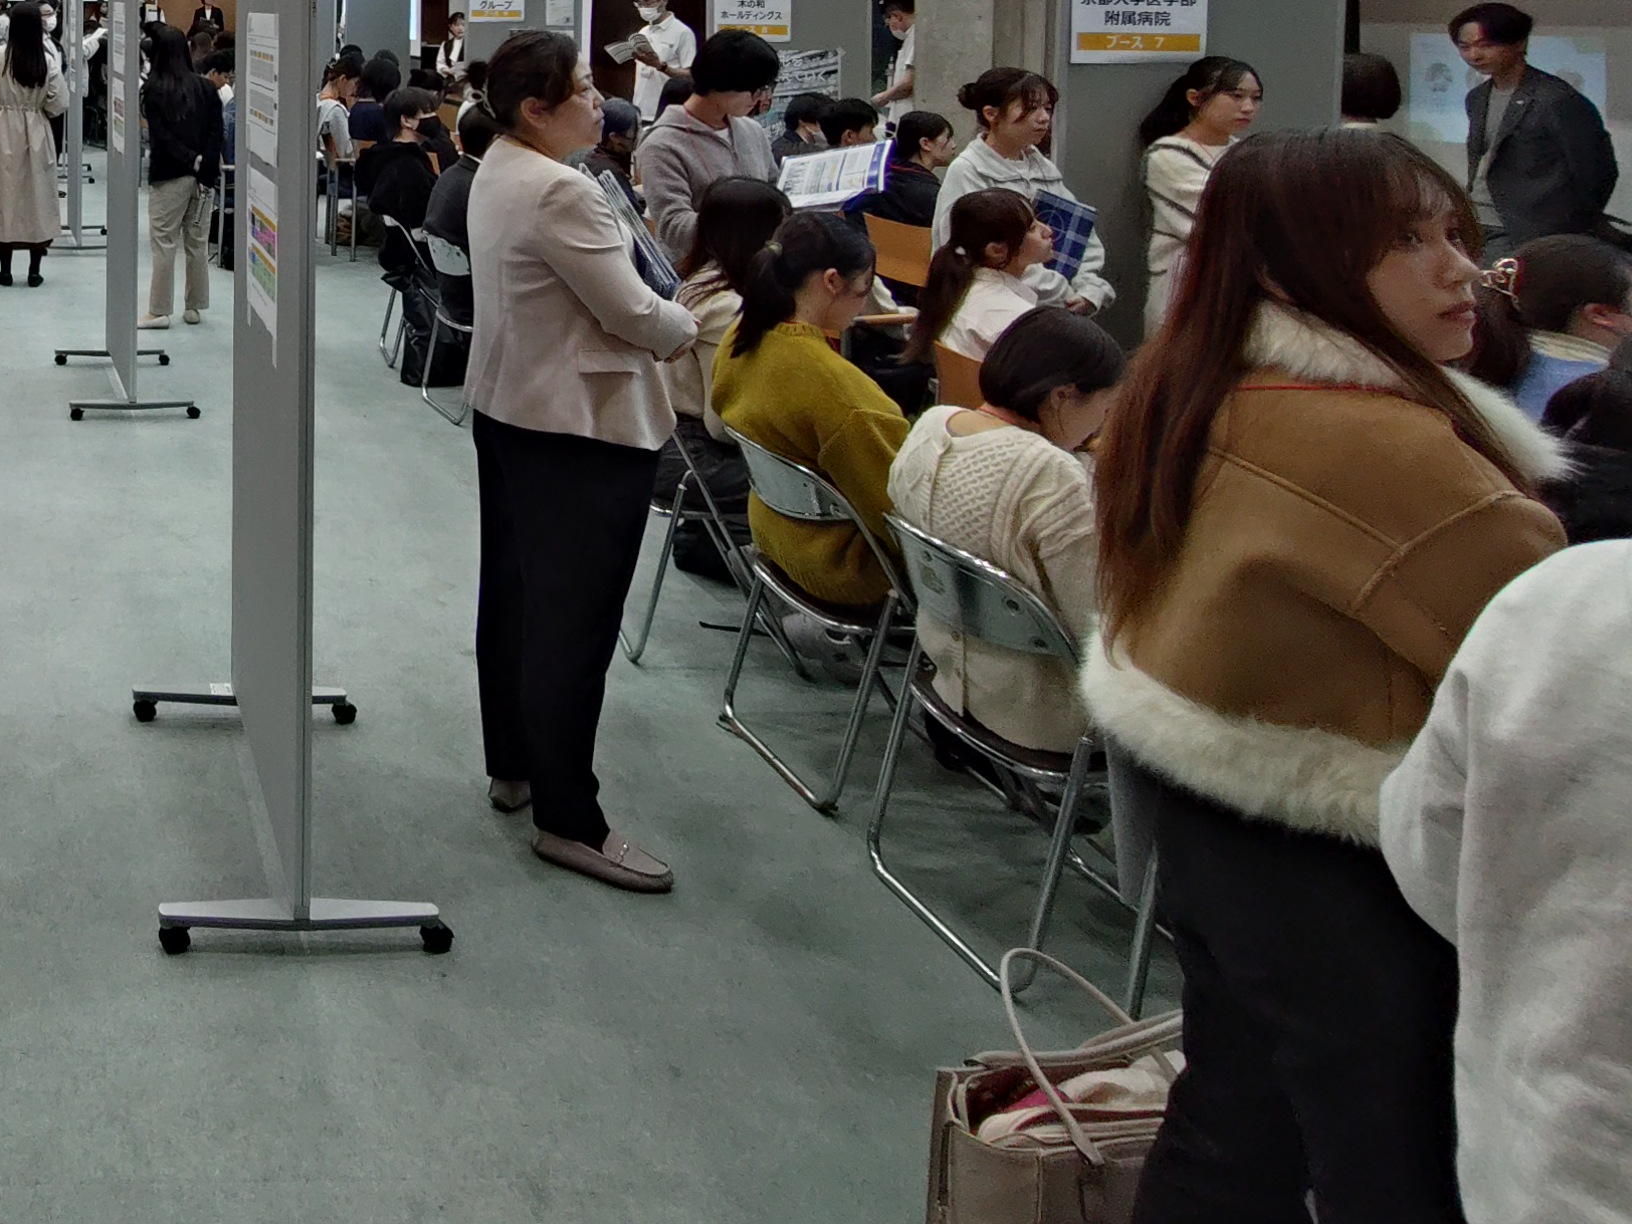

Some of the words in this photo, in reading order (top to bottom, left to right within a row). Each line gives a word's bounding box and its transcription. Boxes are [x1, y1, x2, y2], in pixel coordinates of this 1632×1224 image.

[479, 0, 514, 10] グループ
[737, 0, 766, 9] 木の和
[720, 10, 783, 21] ホールディングス
[1104, 10, 1171, 27] 附属病院
[1106, 35, 1144, 50] ブース
[1154, 36, 1165, 49] 7
